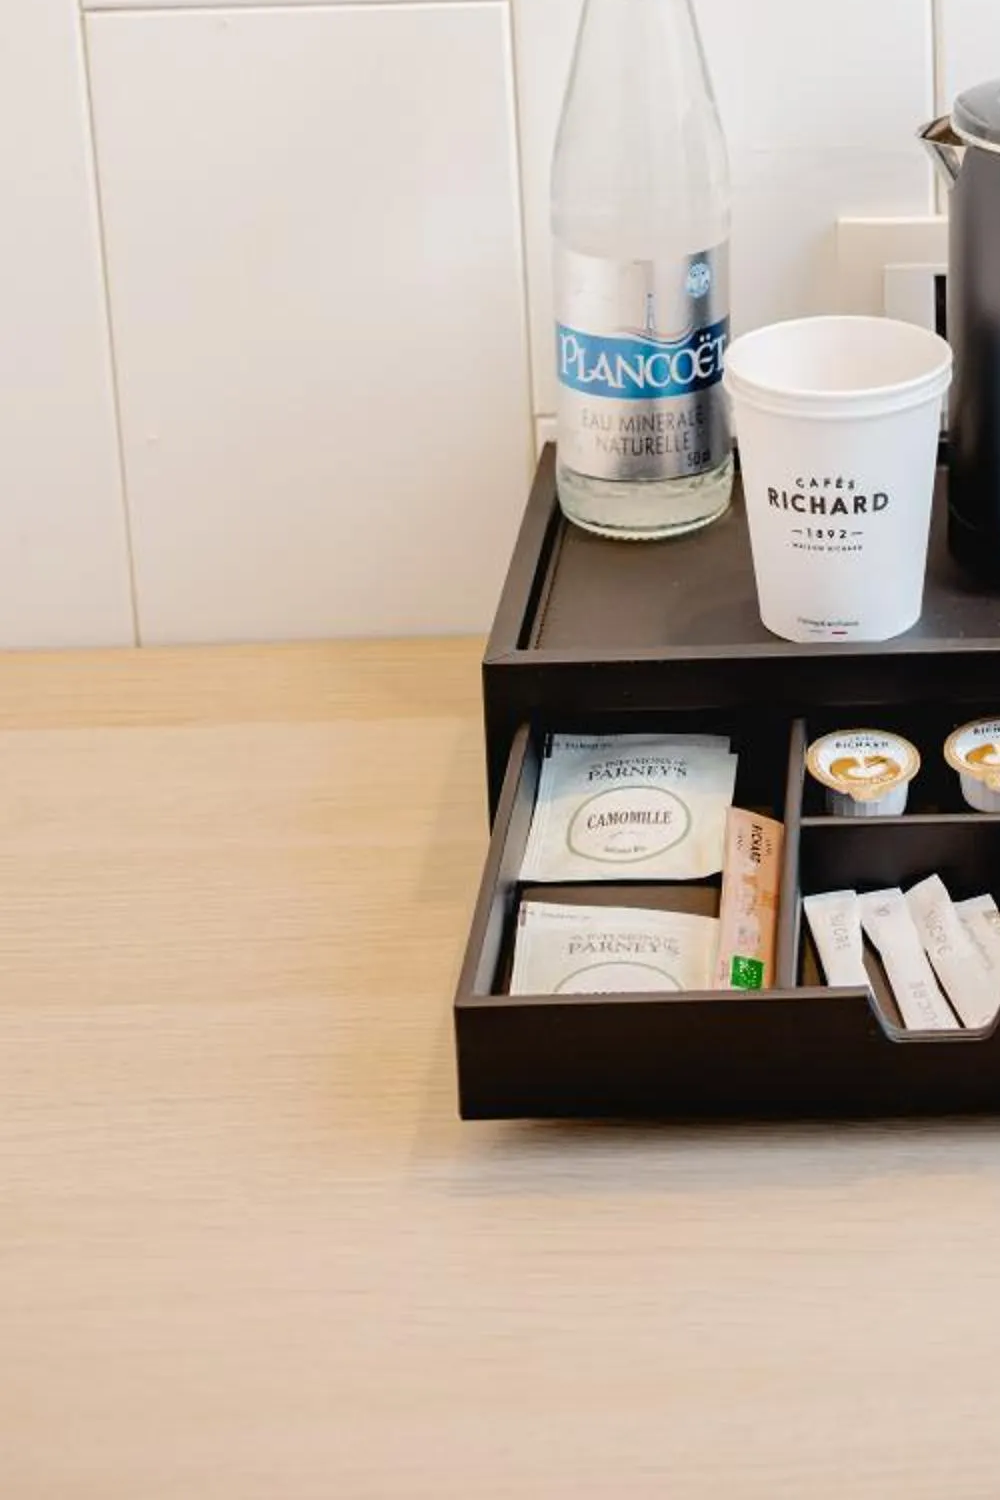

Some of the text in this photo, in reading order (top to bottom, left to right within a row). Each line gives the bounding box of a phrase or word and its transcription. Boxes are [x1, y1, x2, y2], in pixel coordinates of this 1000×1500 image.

[560, 333, 727, 388] PLANCOËT
[582, 408, 613, 431] EAU
[595, 430, 691, 457] NATURELLE
[795, 474, 855, 490] CAFÉS
[767, 486, 890, 516] RICHARD
[805, 527, 848, 540] 1892
[587, 764, 688, 782] PARNEY'S
[587, 810, 673, 830] CAMOMILLE
[567, 940, 682, 957] PARNEY'S
